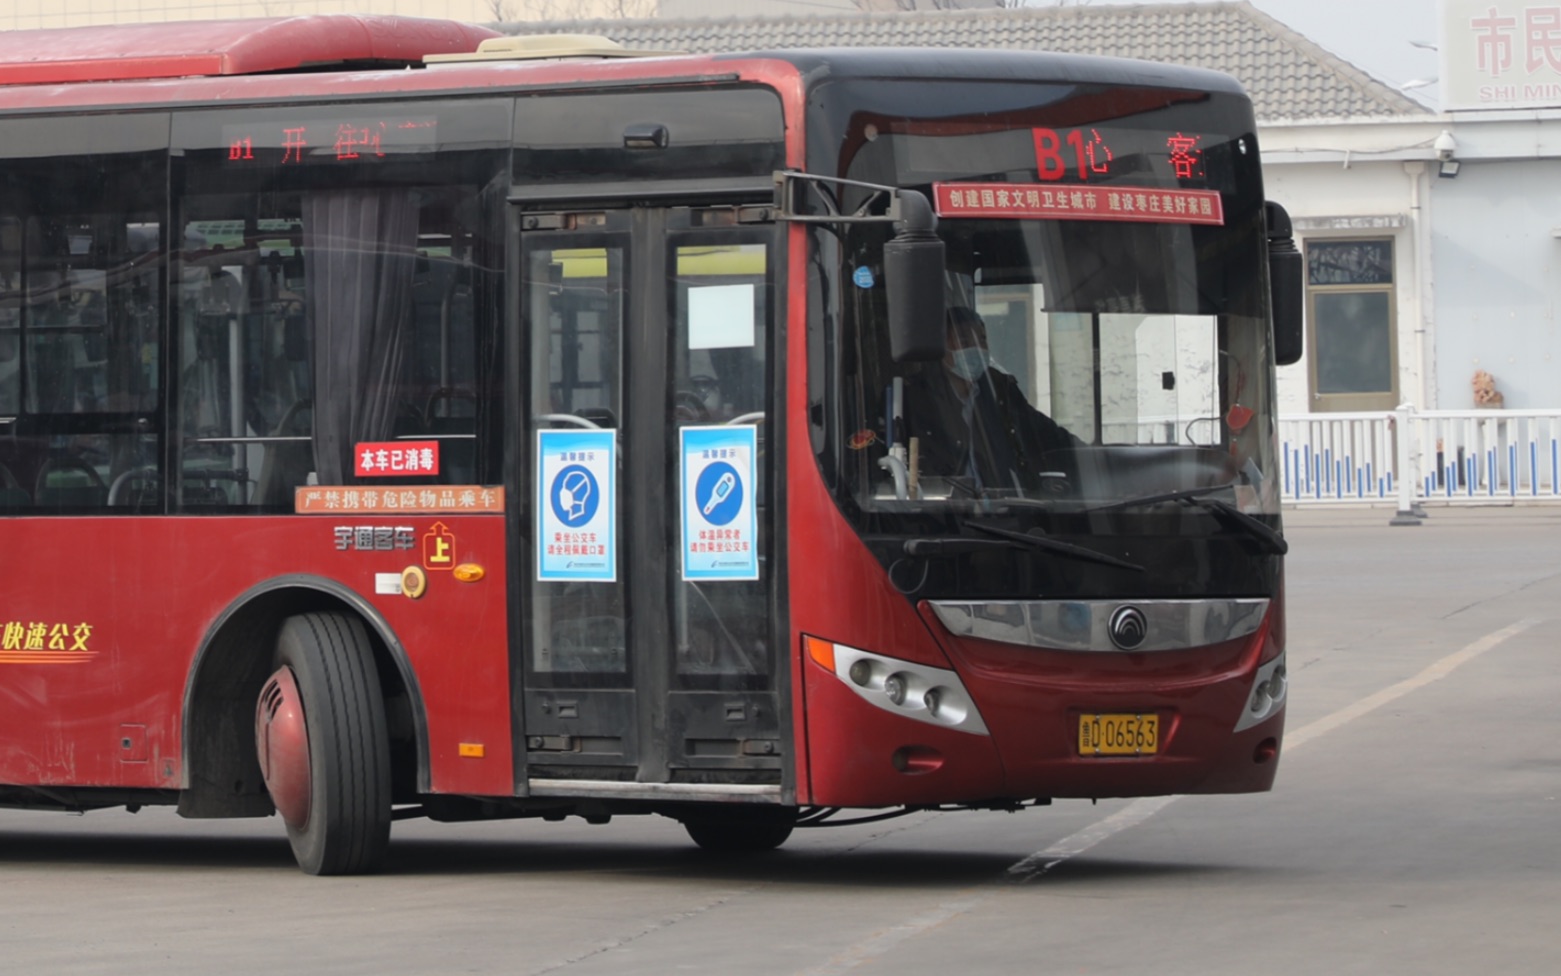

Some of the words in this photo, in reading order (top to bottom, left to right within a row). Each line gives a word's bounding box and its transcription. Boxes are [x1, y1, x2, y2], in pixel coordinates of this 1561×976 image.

[1471, 7, 1561, 75] 市民
[1479, 85, 1516, 101] SHI
[1032, 127, 1088, 181] B1
[949, 189, 1097, 209] 创建国家文明卫生城市
[1108, 193, 1212, 215] 建设枣庄美好家园
[361, 448, 434, 471] 本车已消毒
[304, 490, 496, 509] 严禁携带危险物品乘车
[334, 526, 415, 550] 宇通客车
[430, 537, 450, 562] 上
